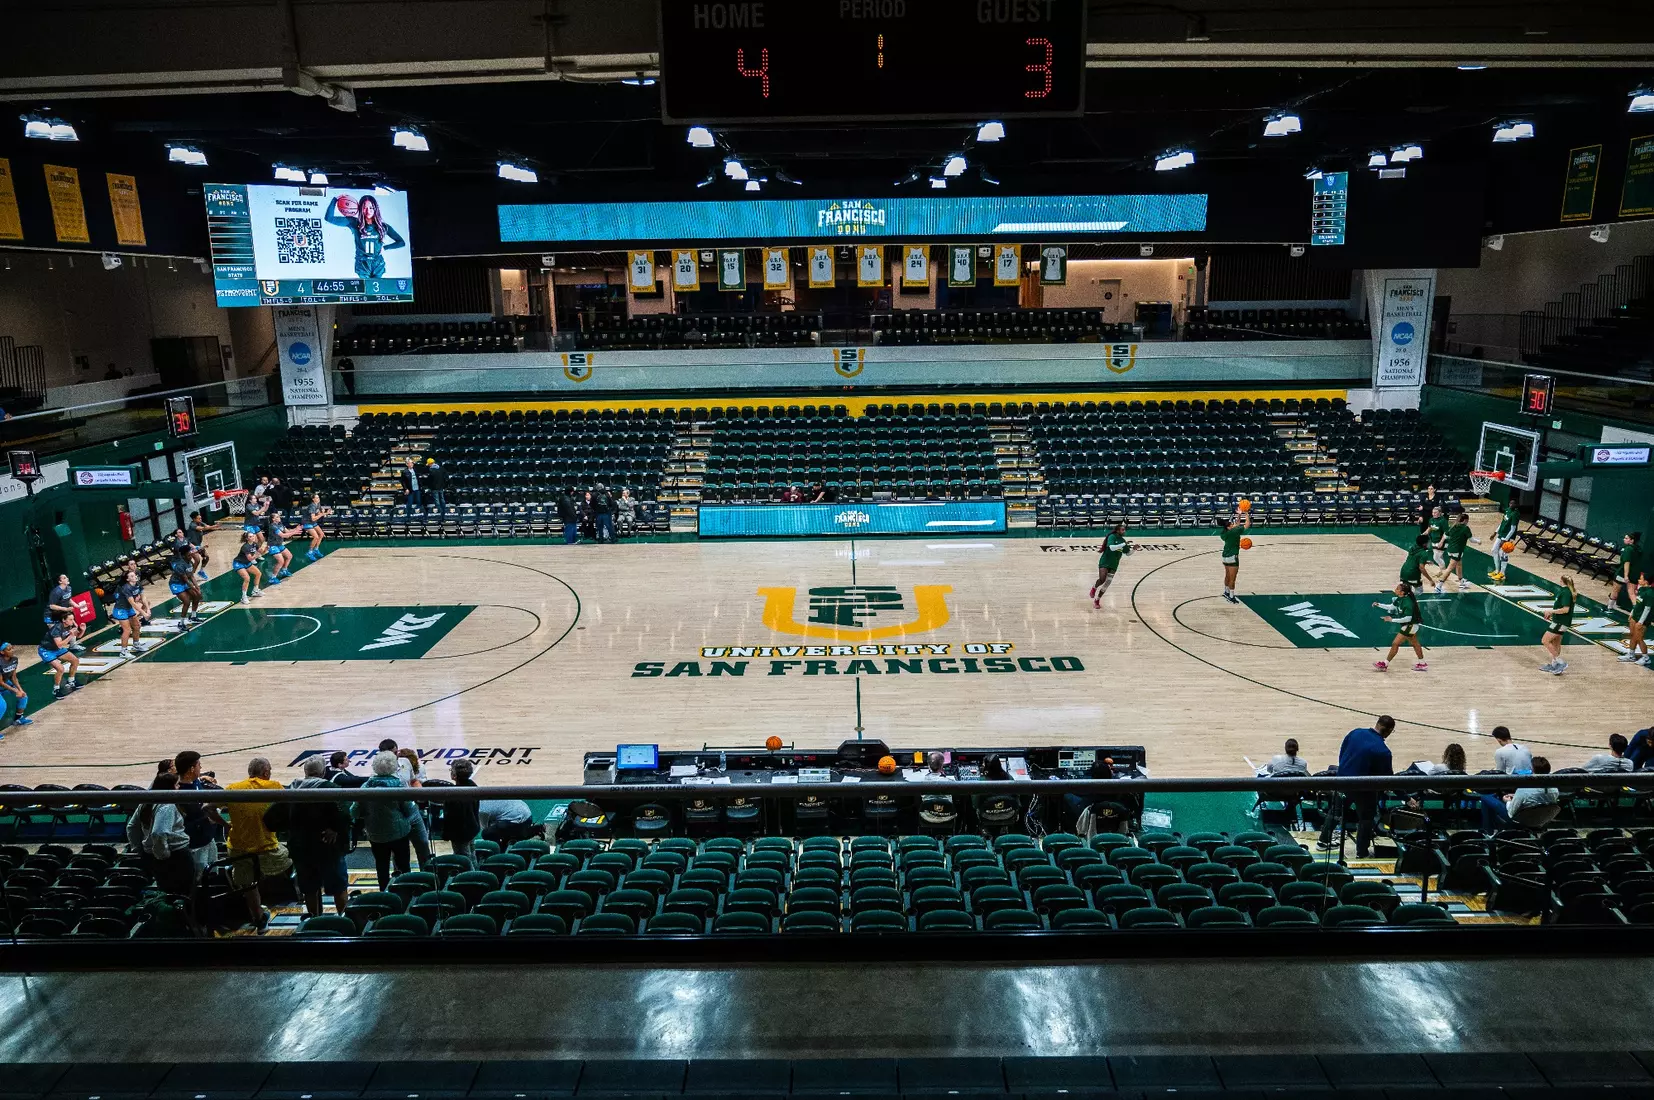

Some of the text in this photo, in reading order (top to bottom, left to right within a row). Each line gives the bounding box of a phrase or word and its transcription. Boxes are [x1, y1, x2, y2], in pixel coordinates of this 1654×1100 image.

[693, 3, 765, 29] HOME
[839, 0, 907, 20] PERIOD
[975, 0, 1056, 25] GUEST
[877, 33, 884, 68] 1
[737, 46, 769, 98] 4
[1025, 36, 1054, 98] 3
[208, 193, 243, 203] FRANCISCO
[842, 200, 862, 209] SAN
[818, 208, 885, 228] FRANCISCO
[1003, 259, 1011, 268] 17
[298, 283, 304, 293] 4
[317, 282, 344, 292] 46:55
[373, 282, 380, 292] 3
[1390, 289, 1424, 298] FRANCISCO
[278, 310, 311, 318] FRANCISCO
[1530, 390, 1545, 410] 30
[173, 412, 189, 432] 30
[700, 641, 1014, 658] UNIVERSITY OF
[630, 656, 1085, 678] SAN FRANCISCO
[346, 747, 542, 760] PRVIDENT
